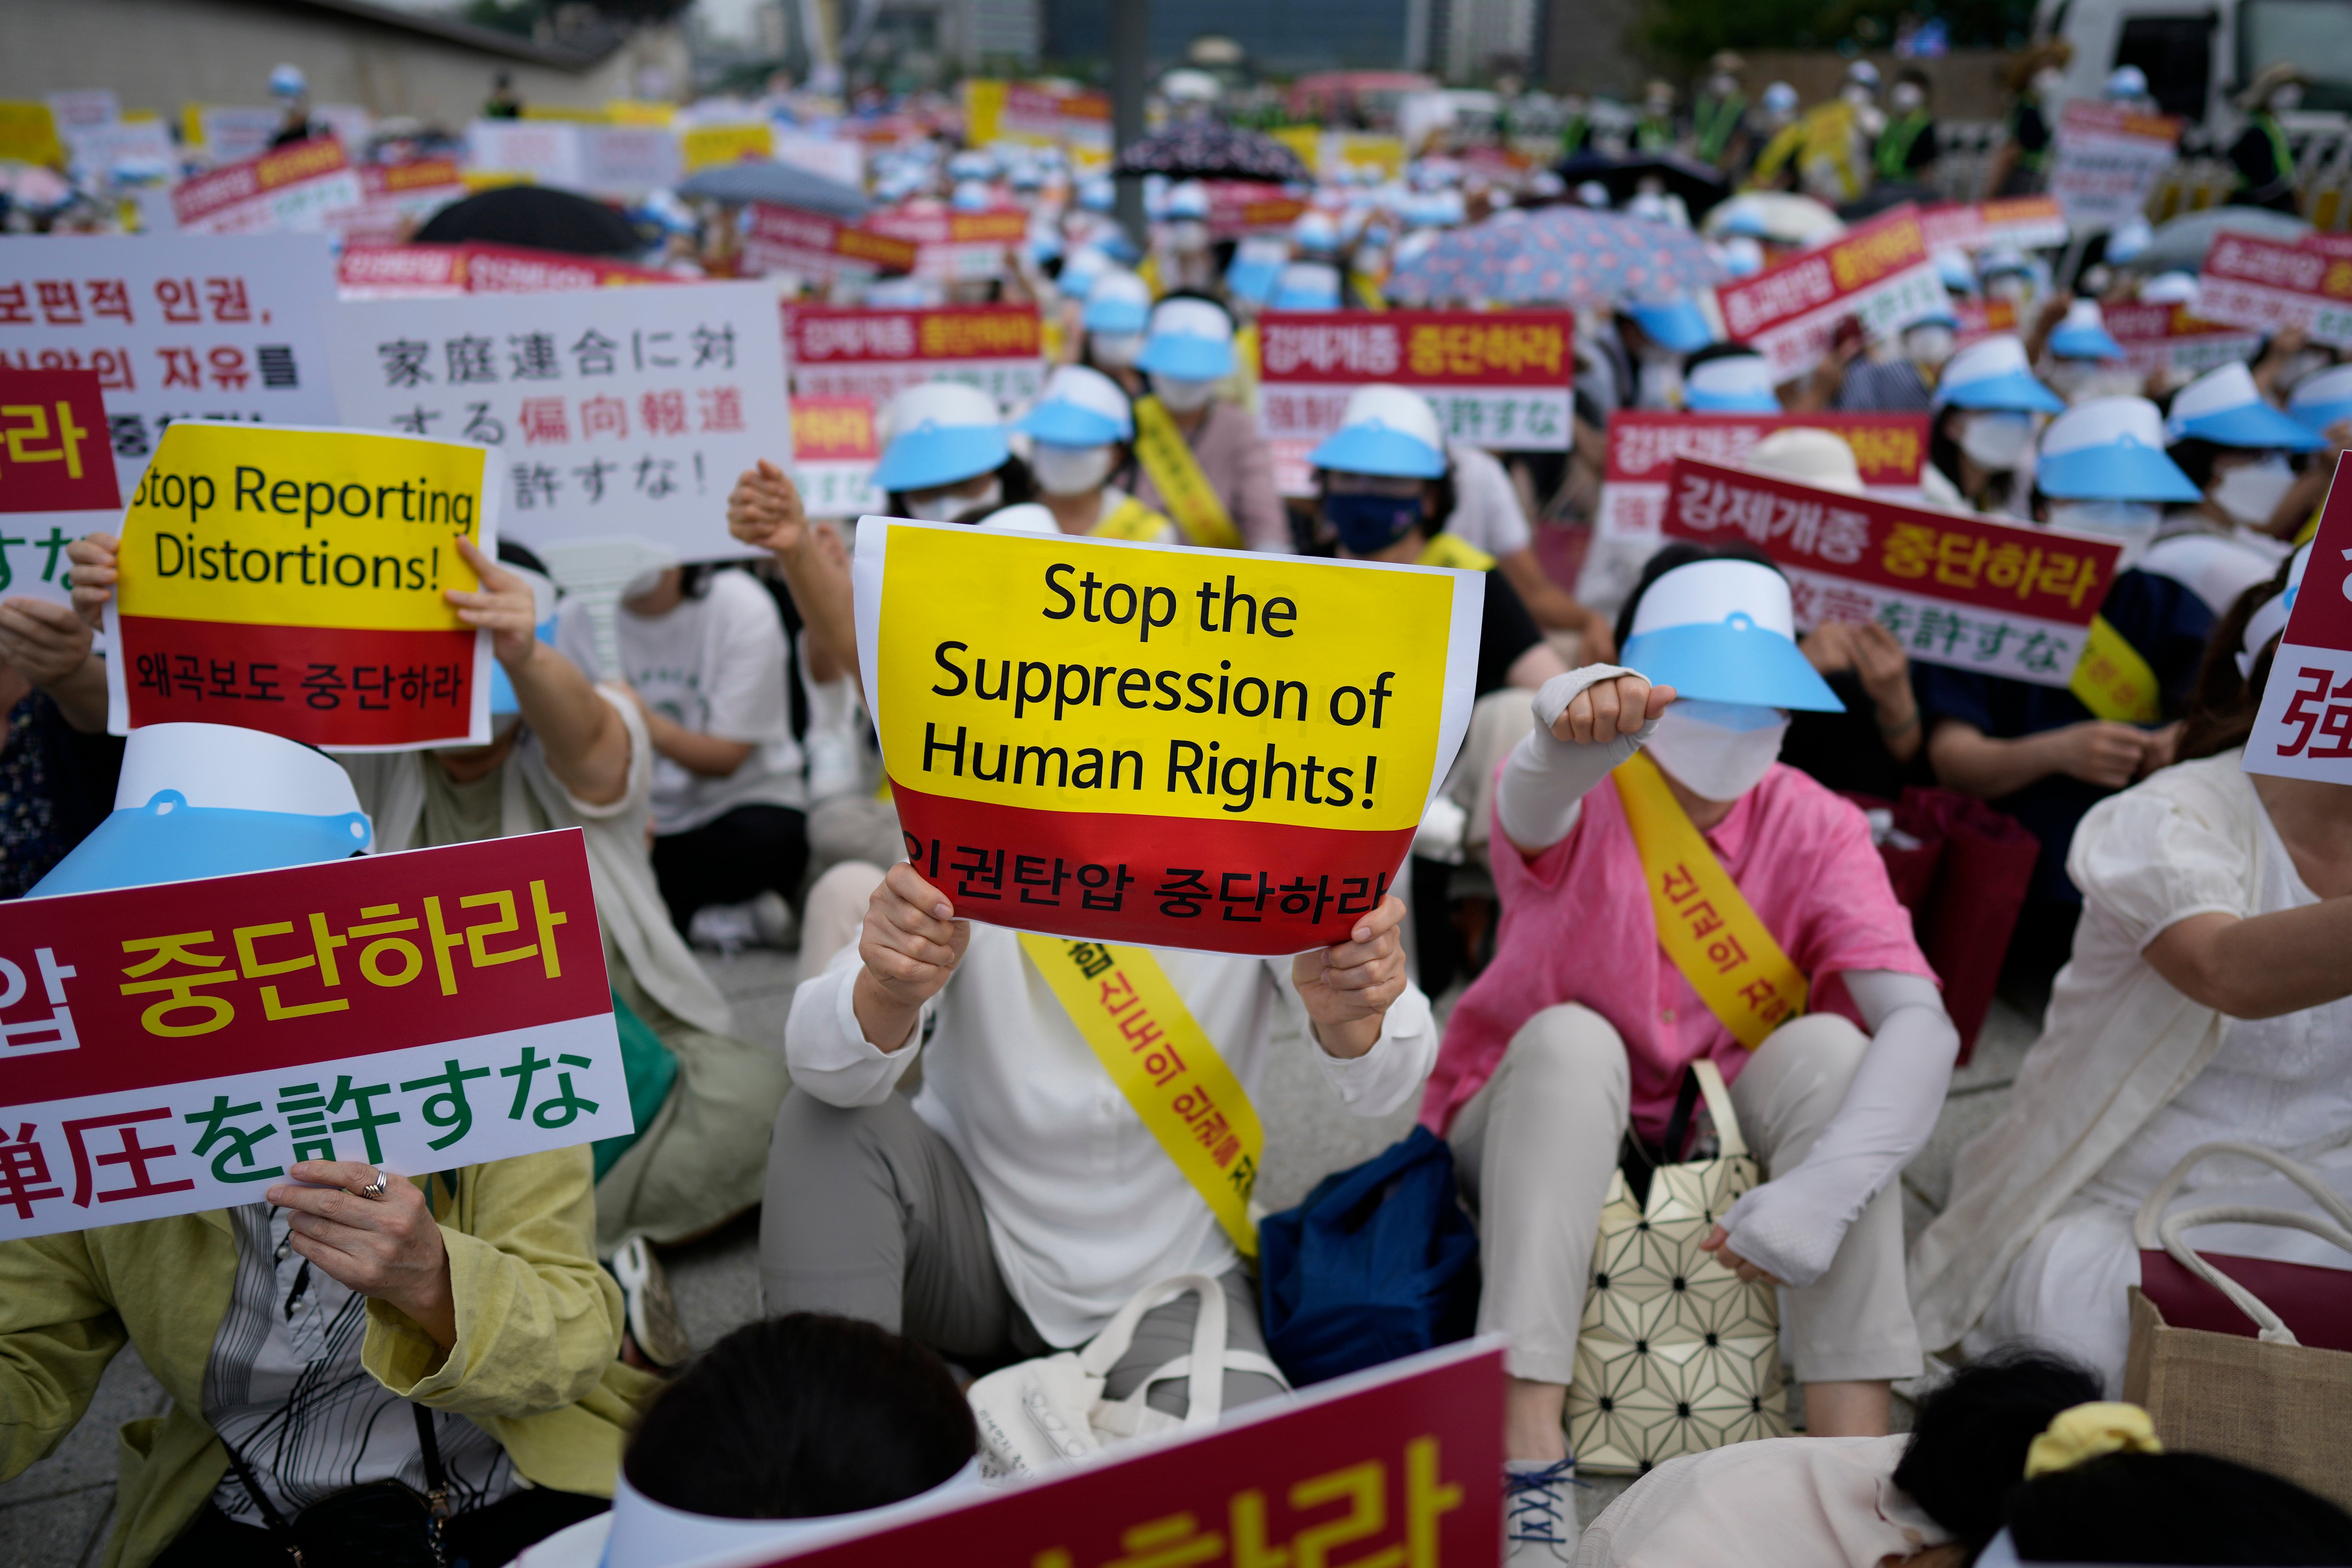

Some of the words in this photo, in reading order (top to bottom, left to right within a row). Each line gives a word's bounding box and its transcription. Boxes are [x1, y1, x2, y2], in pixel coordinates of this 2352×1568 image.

[154, 276, 272, 326] 인권,
[156, 344, 299, 390] 자유를
[377, 320, 737, 388] 家庭連合に対
[1263, 322, 1401, 375] 강제개종
[1409, 321, 1563, 376] 중단하라
[0, 400, 88, 479] 라
[235, 465, 473, 537] Reporting
[155, 531, 438, 591] Distortions!
[1678, 474, 1871, 564] 강제개종
[1883, 521, 2099, 610] 중단하라
[1042, 563, 1176, 642] Stop
[1196, 575, 1297, 638] the
[136, 652, 285, 702] 왜곡보도
[300, 662, 462, 710] 중단하라
[931, 641, 1308, 721] Suppression
[1330, 671, 1396, 729] of
[923, 722, 1143, 790] Human
[1167, 739, 1377, 813] Rights!
[903, 830, 1134, 912] 인권탄압
[1153, 868, 1388, 924] 중단하라
[119, 879, 568, 1038] 중단하라
[1098, 970, 1187, 1087] 신도의
